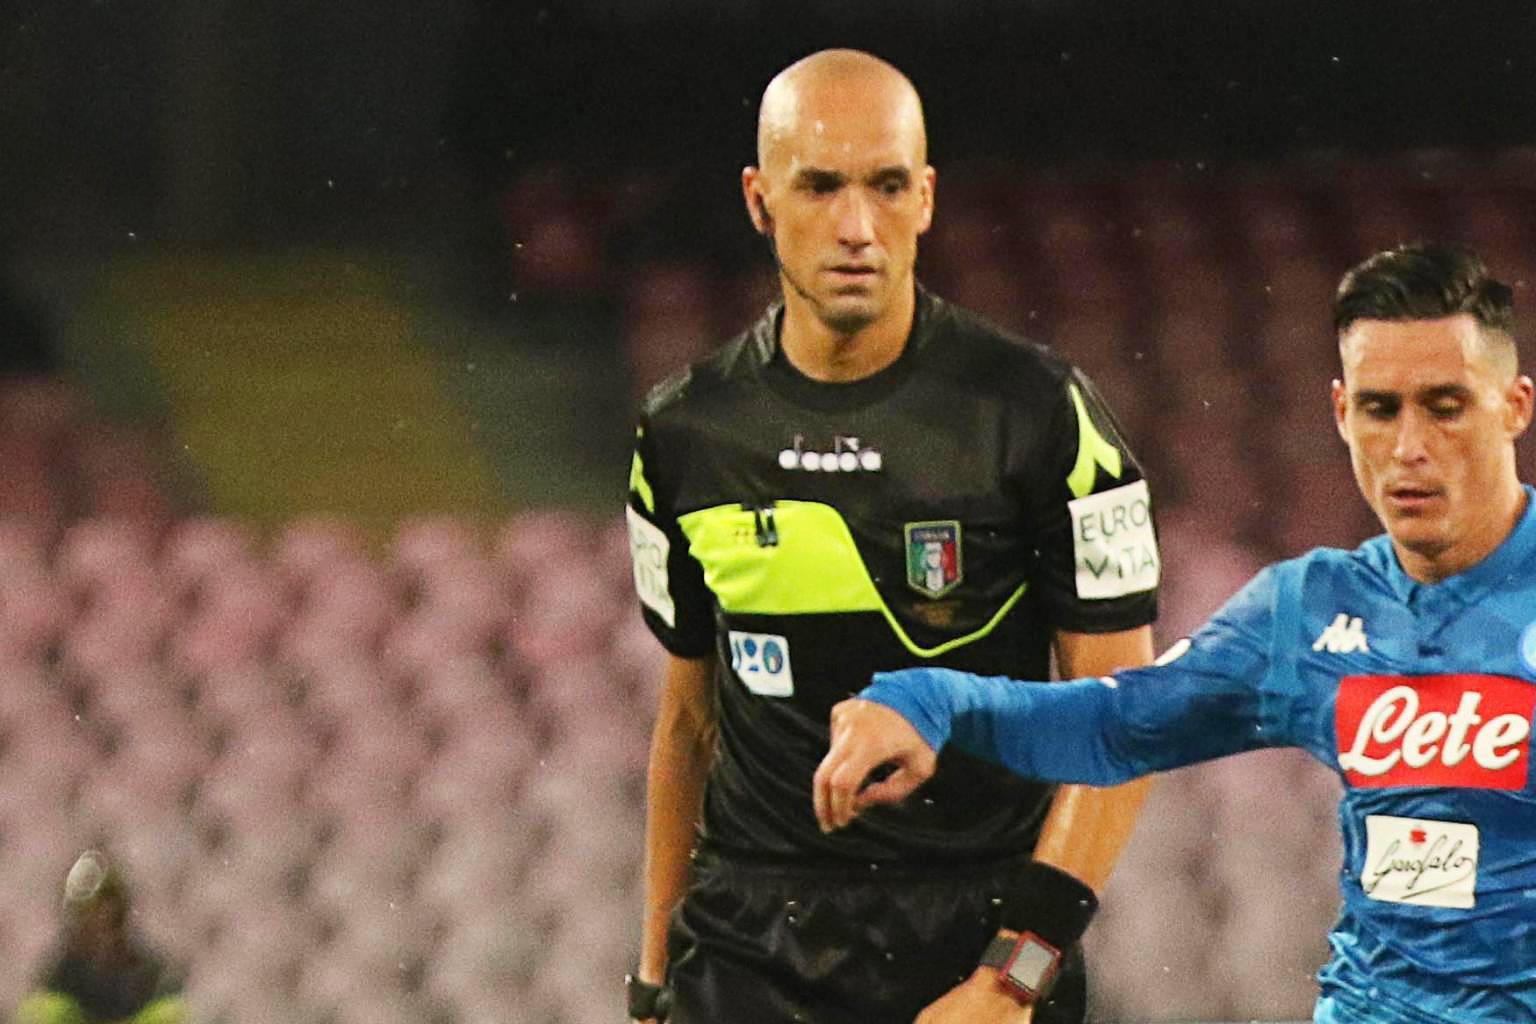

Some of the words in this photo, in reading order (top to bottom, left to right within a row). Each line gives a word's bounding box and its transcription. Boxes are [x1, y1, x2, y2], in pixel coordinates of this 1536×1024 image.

[1079, 499, 1149, 543] EURO
[1083, 545, 1155, 580] VITA
[1338, 685, 1530, 776] Lete
